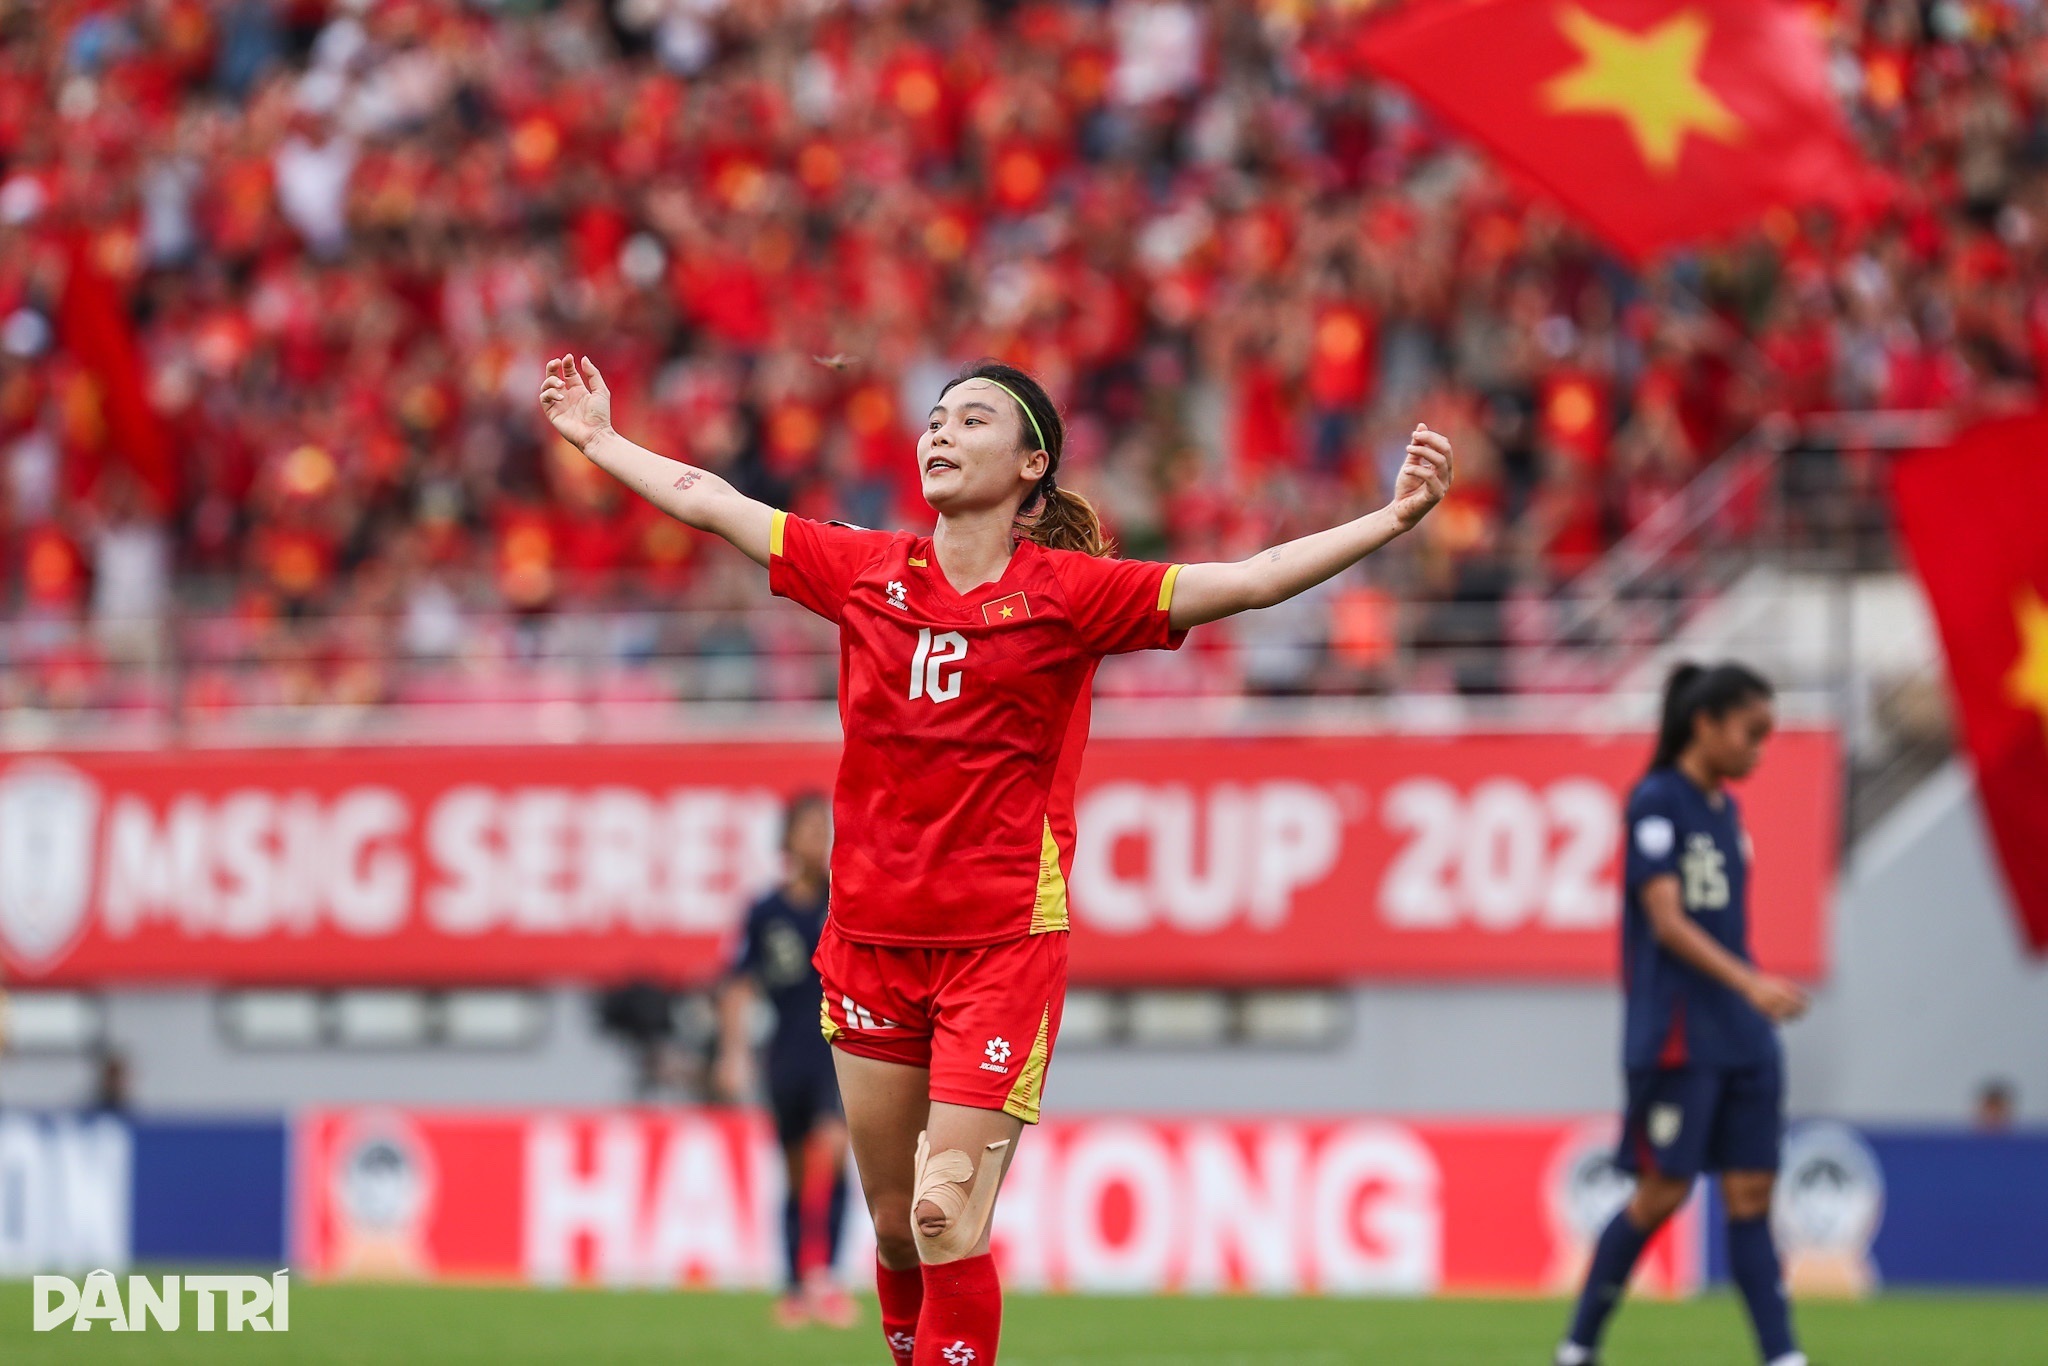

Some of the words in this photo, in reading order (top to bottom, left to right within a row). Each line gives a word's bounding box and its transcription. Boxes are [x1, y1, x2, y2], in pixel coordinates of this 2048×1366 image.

[909, 627, 968, 704] 12
[104, 786, 413, 941] MSIG
[424, 782, 782, 938] SERE
[1071, 779, 1343, 935] CUP
[1377, 774, 1625, 933] 202
